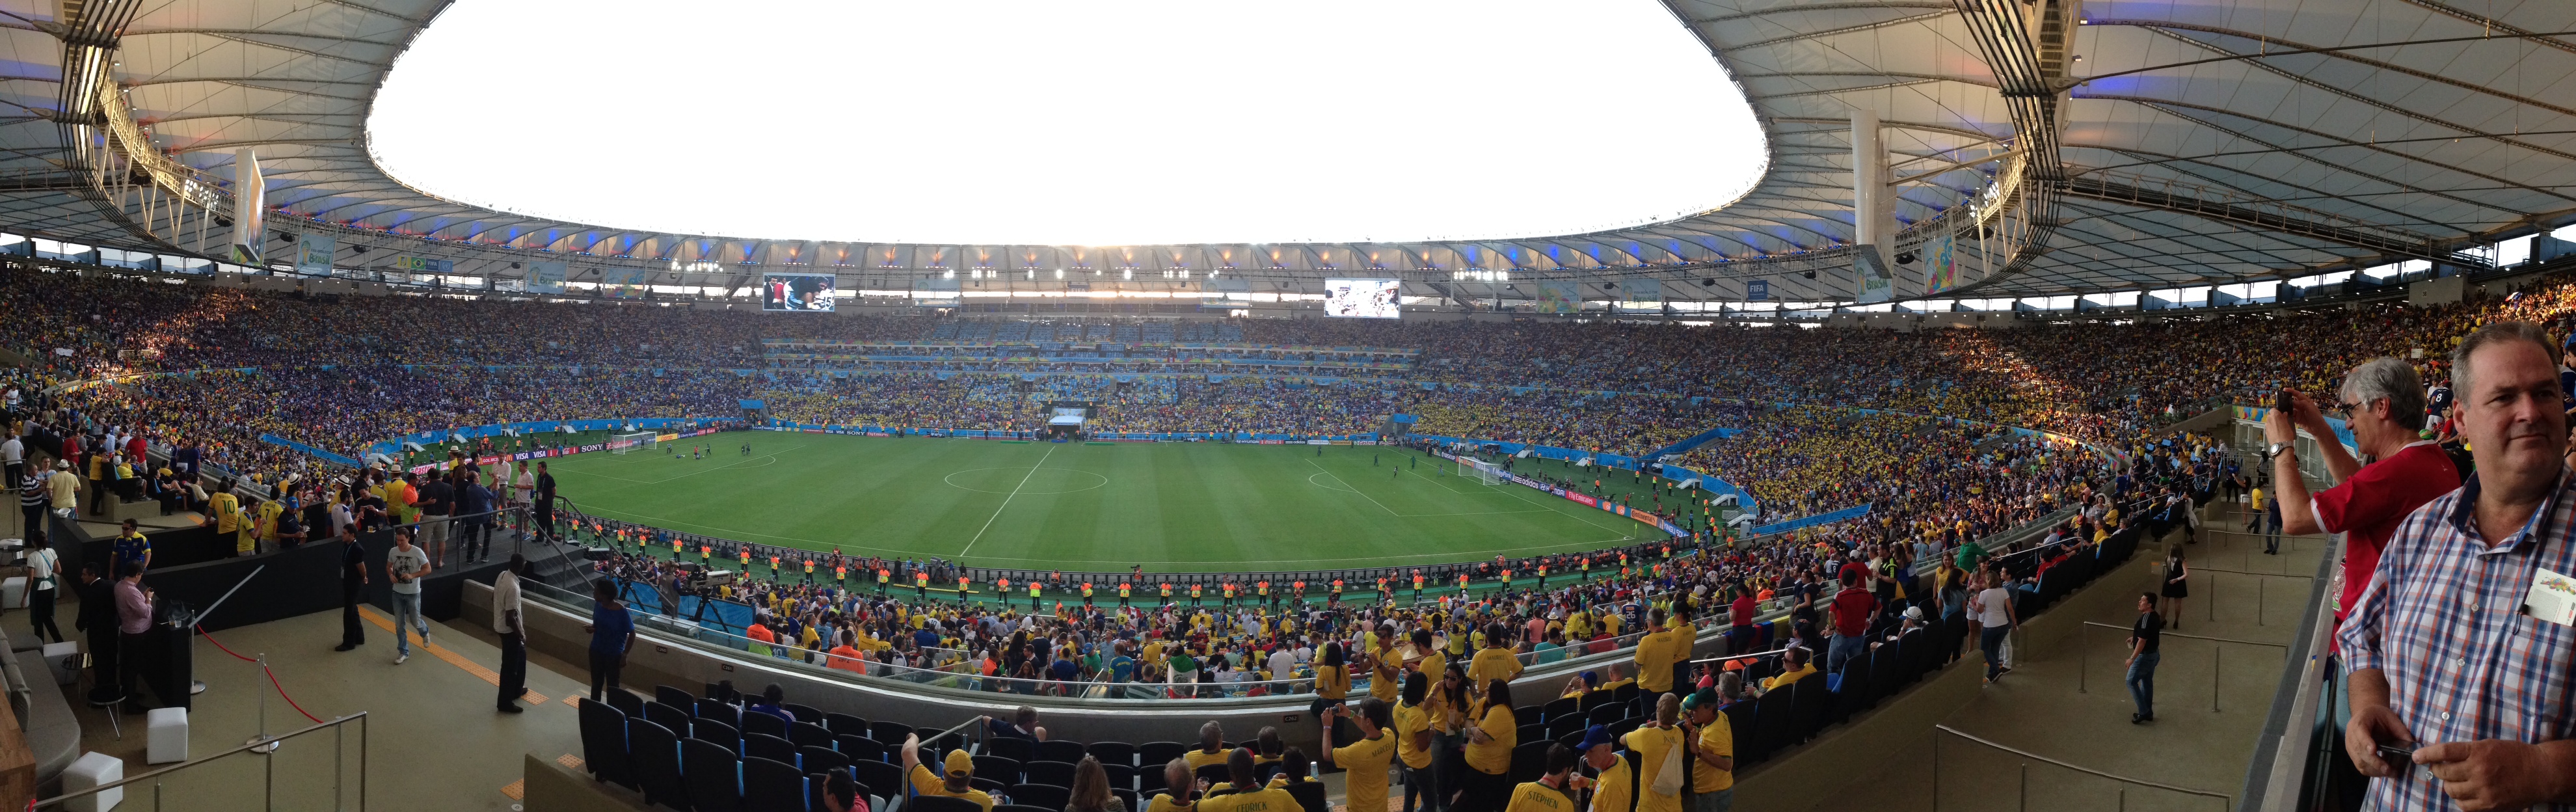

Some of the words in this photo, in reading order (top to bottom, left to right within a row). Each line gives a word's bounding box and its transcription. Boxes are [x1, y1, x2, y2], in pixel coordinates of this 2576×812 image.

[309, 253, 330, 265] Brasil
[1866, 278, 1888, 290] Brasil
[2435, 393, 2442, 402] 8
[1522, 479, 1538, 489] adidas
[1576, 494, 1593, 505] Emirates
[222, 500, 235, 514] 10
[265, 509, 270, 520] 7
[1631, 510, 1654, 522] Continental
[1664, 522, 1676, 534] YINGLI
[126, 550, 129, 558] 7
[818, 631, 824, 640] 5
[1372, 741, 1393, 757] MARCELO
[1528, 791, 1559, 809] STEPHEN
[1237, 801, 1267, 812] CEDRICK
